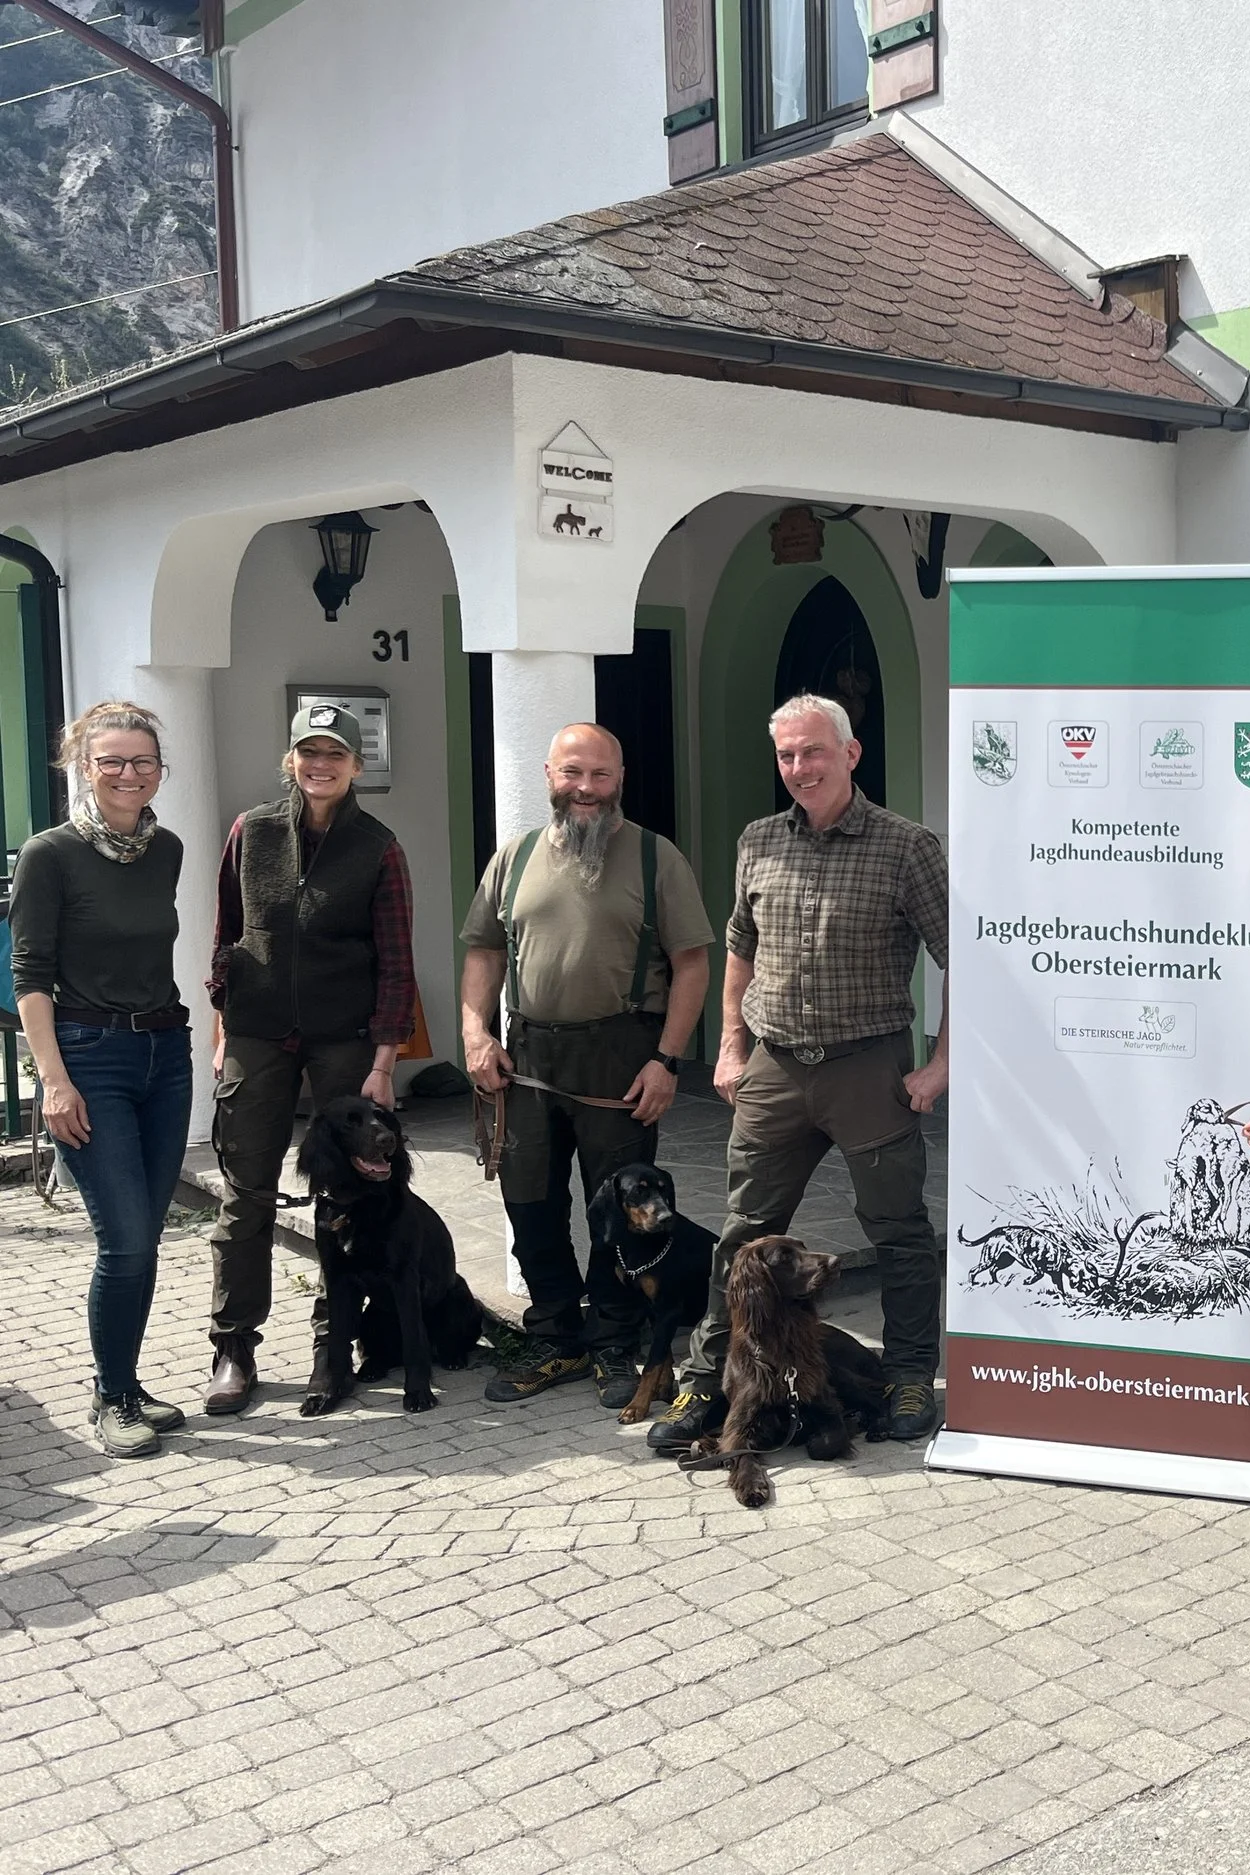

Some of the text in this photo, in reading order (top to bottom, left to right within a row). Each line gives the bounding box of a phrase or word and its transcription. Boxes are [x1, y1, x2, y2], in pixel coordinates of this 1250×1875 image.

[543, 464, 613, 482] WELCOME
[372, 630, 409, 662] 31
[1071, 818, 1180, 841] Kompetente
[1030, 842, 1224, 870] Jagdhundeausbildung
[1031, 950, 1222, 981] Obersteiermark
[1061, 1026, 1162, 1042] DIE STEIRISCHE JAGD
[1123, 1040, 1144, 1049] Natur
